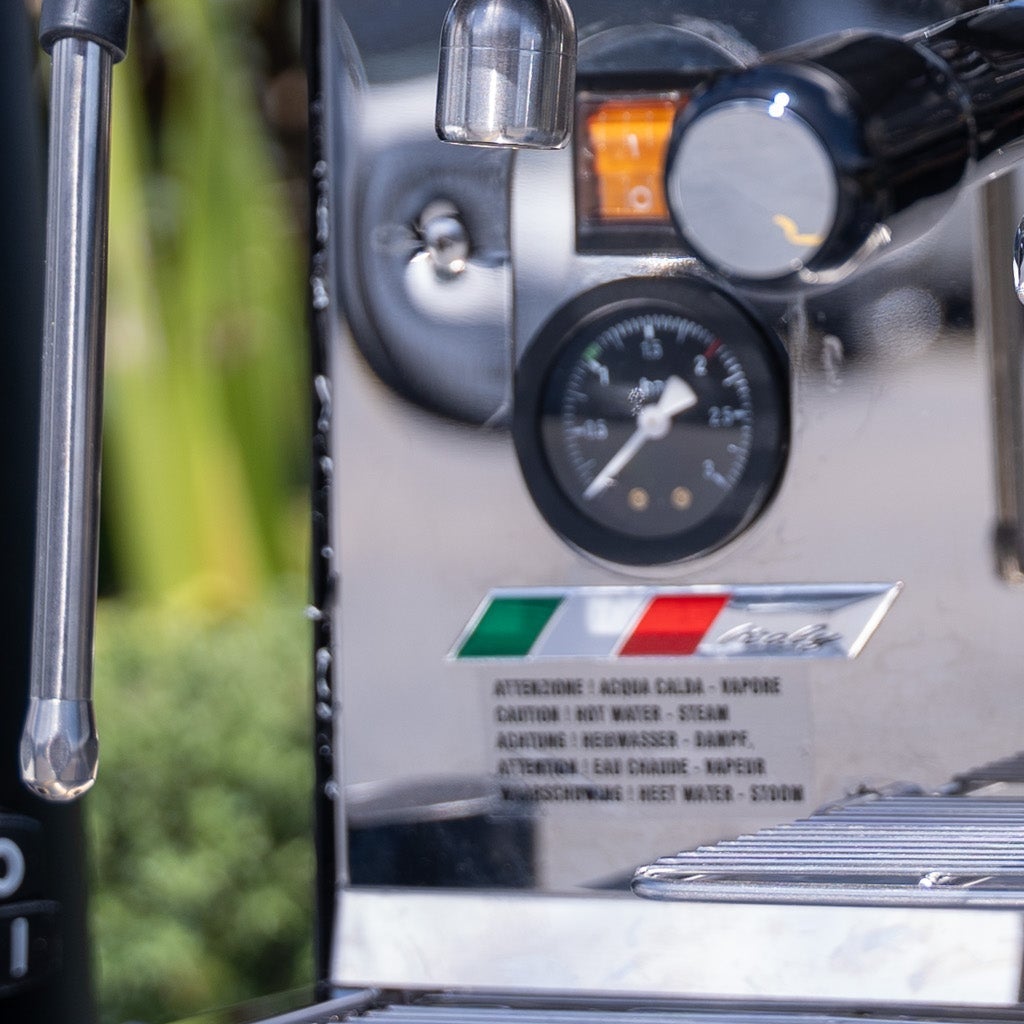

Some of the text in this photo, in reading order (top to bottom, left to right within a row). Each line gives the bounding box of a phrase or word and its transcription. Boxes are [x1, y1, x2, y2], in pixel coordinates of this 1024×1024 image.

[495, 678, 583, 695] ATTENZIONE
[600, 678, 649, 695] ACQUA
[655, 677, 703, 694] CALDA
[722, 677, 781, 694] VAPORE
[496, 705, 559, 722] CAUTION
[576, 705, 604, 721] HOT
[611, 705, 661, 721] WATER
[679, 704, 729, 721] STEAM
[497, 731, 566, 748] ACHTUNG
[593, 758, 620, 774] EAU
[628, 757, 688, 775] CHAUDE
[705, 757, 765, 774] VAPEUR
[639, 785, 675, 801] HEET
[682, 784, 733, 801] WATER
[750, 784, 804, 801] STOOM
